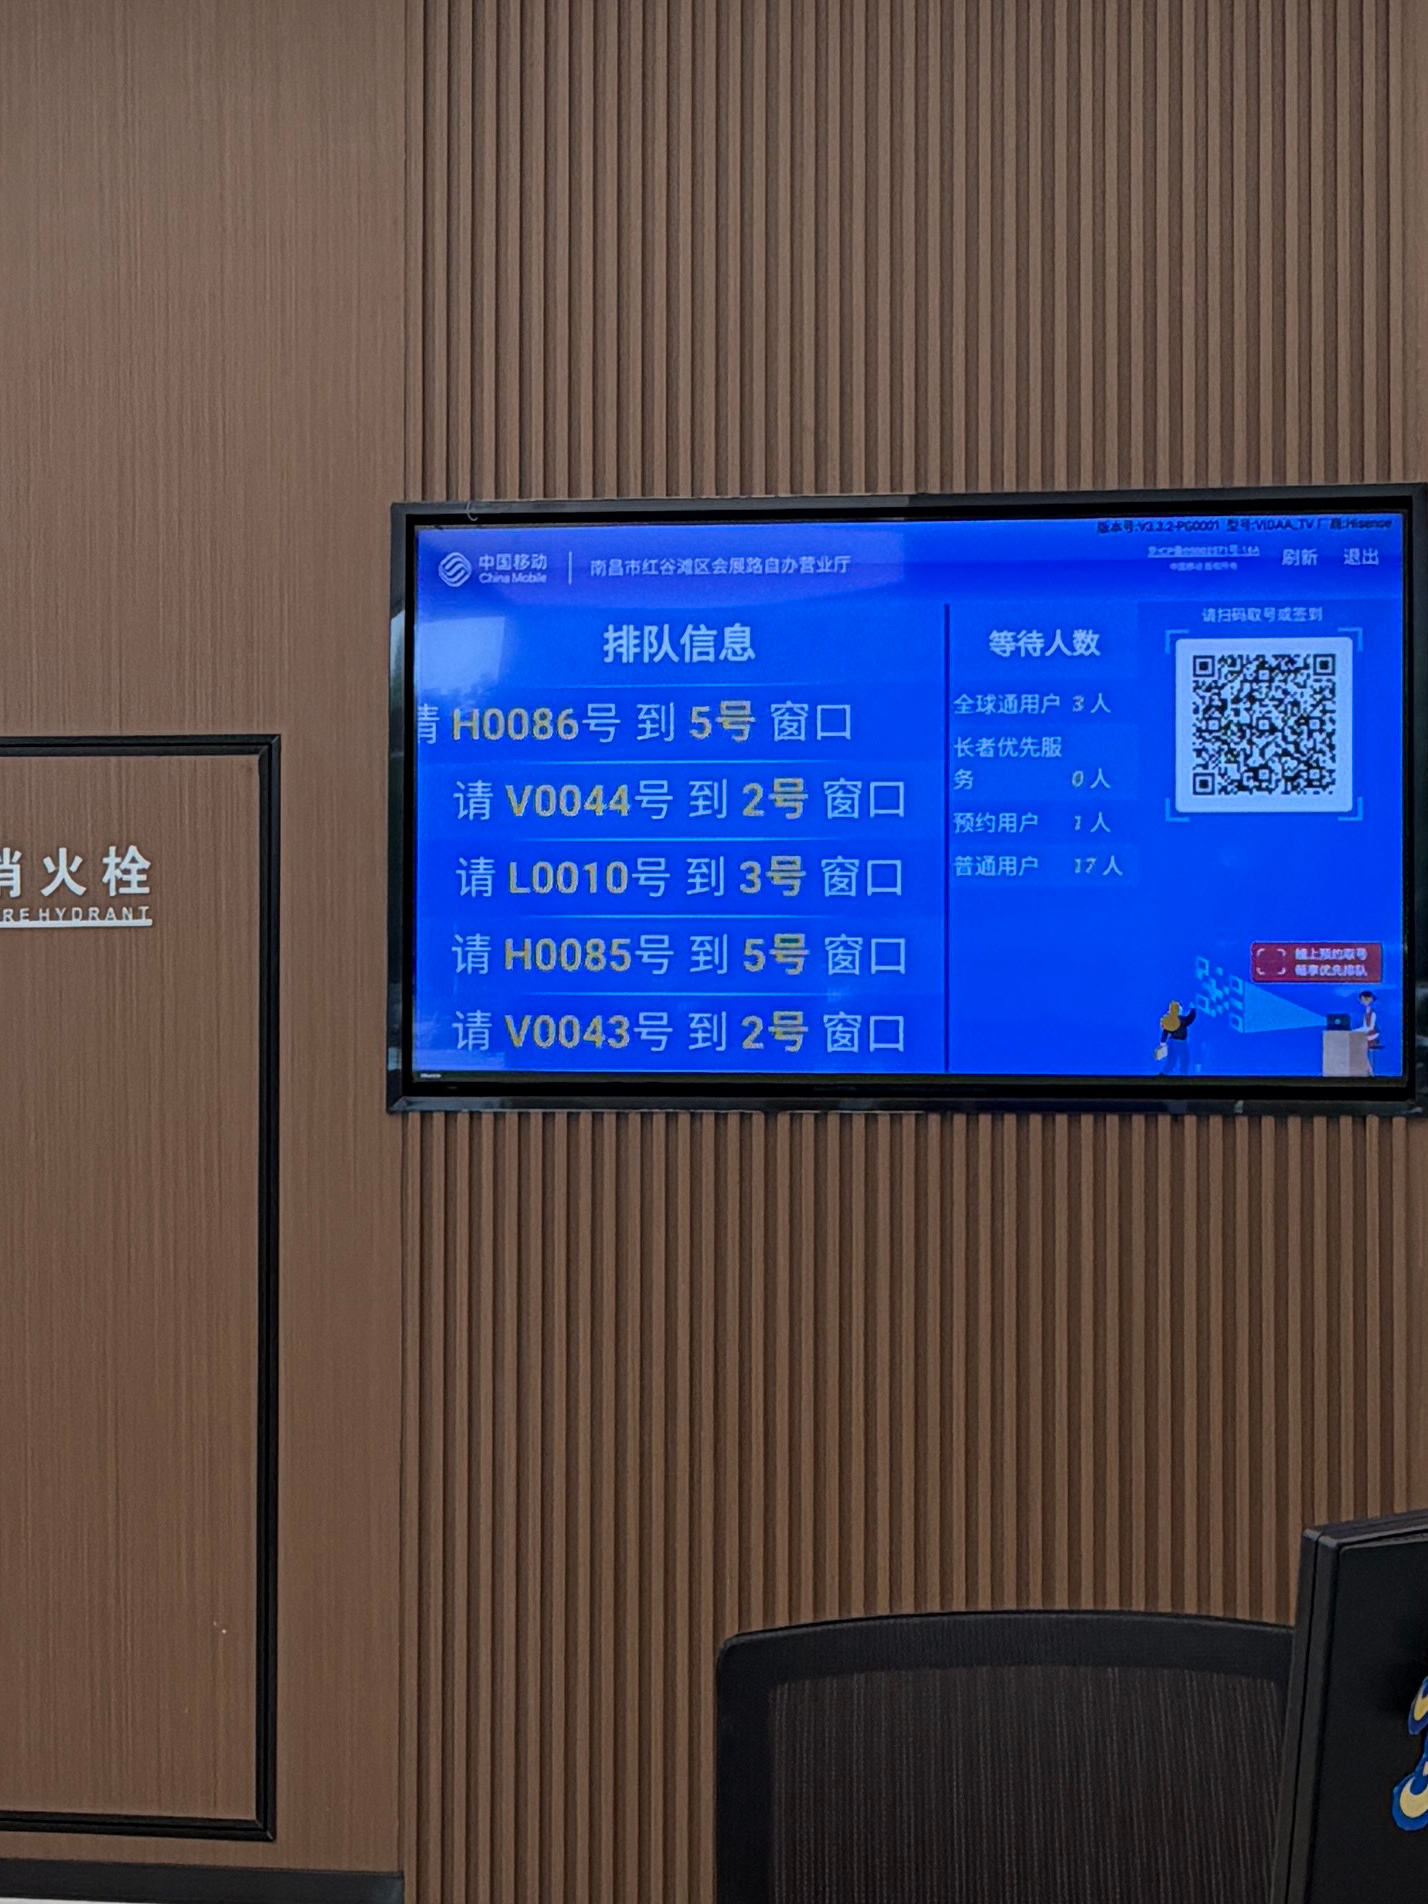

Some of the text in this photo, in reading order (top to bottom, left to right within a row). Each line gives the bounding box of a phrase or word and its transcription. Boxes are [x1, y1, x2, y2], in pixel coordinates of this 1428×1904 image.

[479, 553, 548, 571] 中国移动
[590, 555, 851, 577] 南昌市红谷滩区会展路自办营业厅
[1282, 547, 1380, 567] 刷新 退出
[479, 570, 548, 585] China Mobile
[1202, 607, 1323, 623] 请扫码取号或签到
[603, 623, 756, 664] 排队信息
[989, 629, 1101, 657] 等待人数
[953, 693, 1061, 715] 全球通用户
[1090, 693, 1112, 713] 人
[452, 703, 620, 744] H0086号
[636, 702, 675, 742] 到
[689, 700, 756, 743] 5号
[771, 701, 852, 742] 窗口
[954, 736, 1062, 758] 长者优先服
[954, 769, 974, 790] 务
[1090, 768, 1112, 789] 人
[453, 777, 905, 821] 请 V0044号 到 2号 窗口
[953, 812, 1039, 834] 预约用户
[1090, 812, 1112, 833] 人
[456, 855, 902, 897] 请 L0010号 到 3号 窗口
[953, 856, 1039, 877] 普通用户
[1102, 856, 1124, 876] 人
[39, 906, 150, 922] HYDRANT
[451, 933, 906, 975] 请 H0085号 到 5号 窗口
[451, 1010, 905, 1052] 请 V0043号 到 2号 窗口
